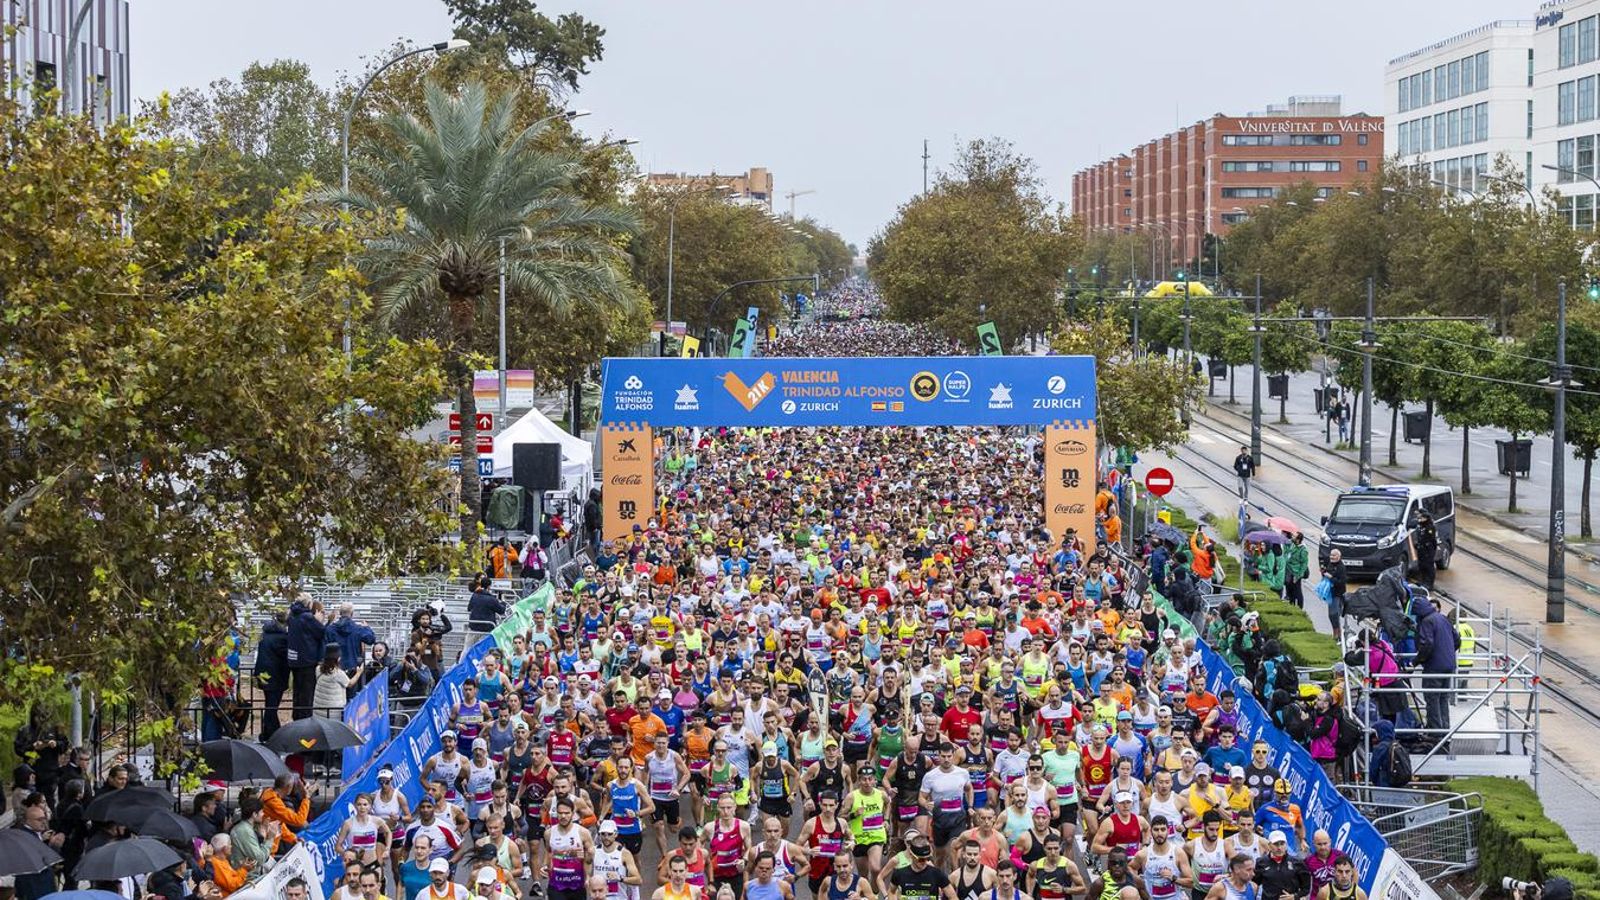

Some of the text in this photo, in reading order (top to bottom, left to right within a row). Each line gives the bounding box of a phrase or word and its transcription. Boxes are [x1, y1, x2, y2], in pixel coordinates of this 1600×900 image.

[749, 315, 757, 331] 3
[732, 329, 746, 349] 2
[781, 371, 840, 384] VALENCIA
[747, 379, 769, 404] 21K
[782, 386, 905, 398] TRINIDAD ALFONSO
[800, 402, 839, 411] ZURICH
[1032, 398, 1082, 409] ZURICH
[480, 461, 492, 473] 14
